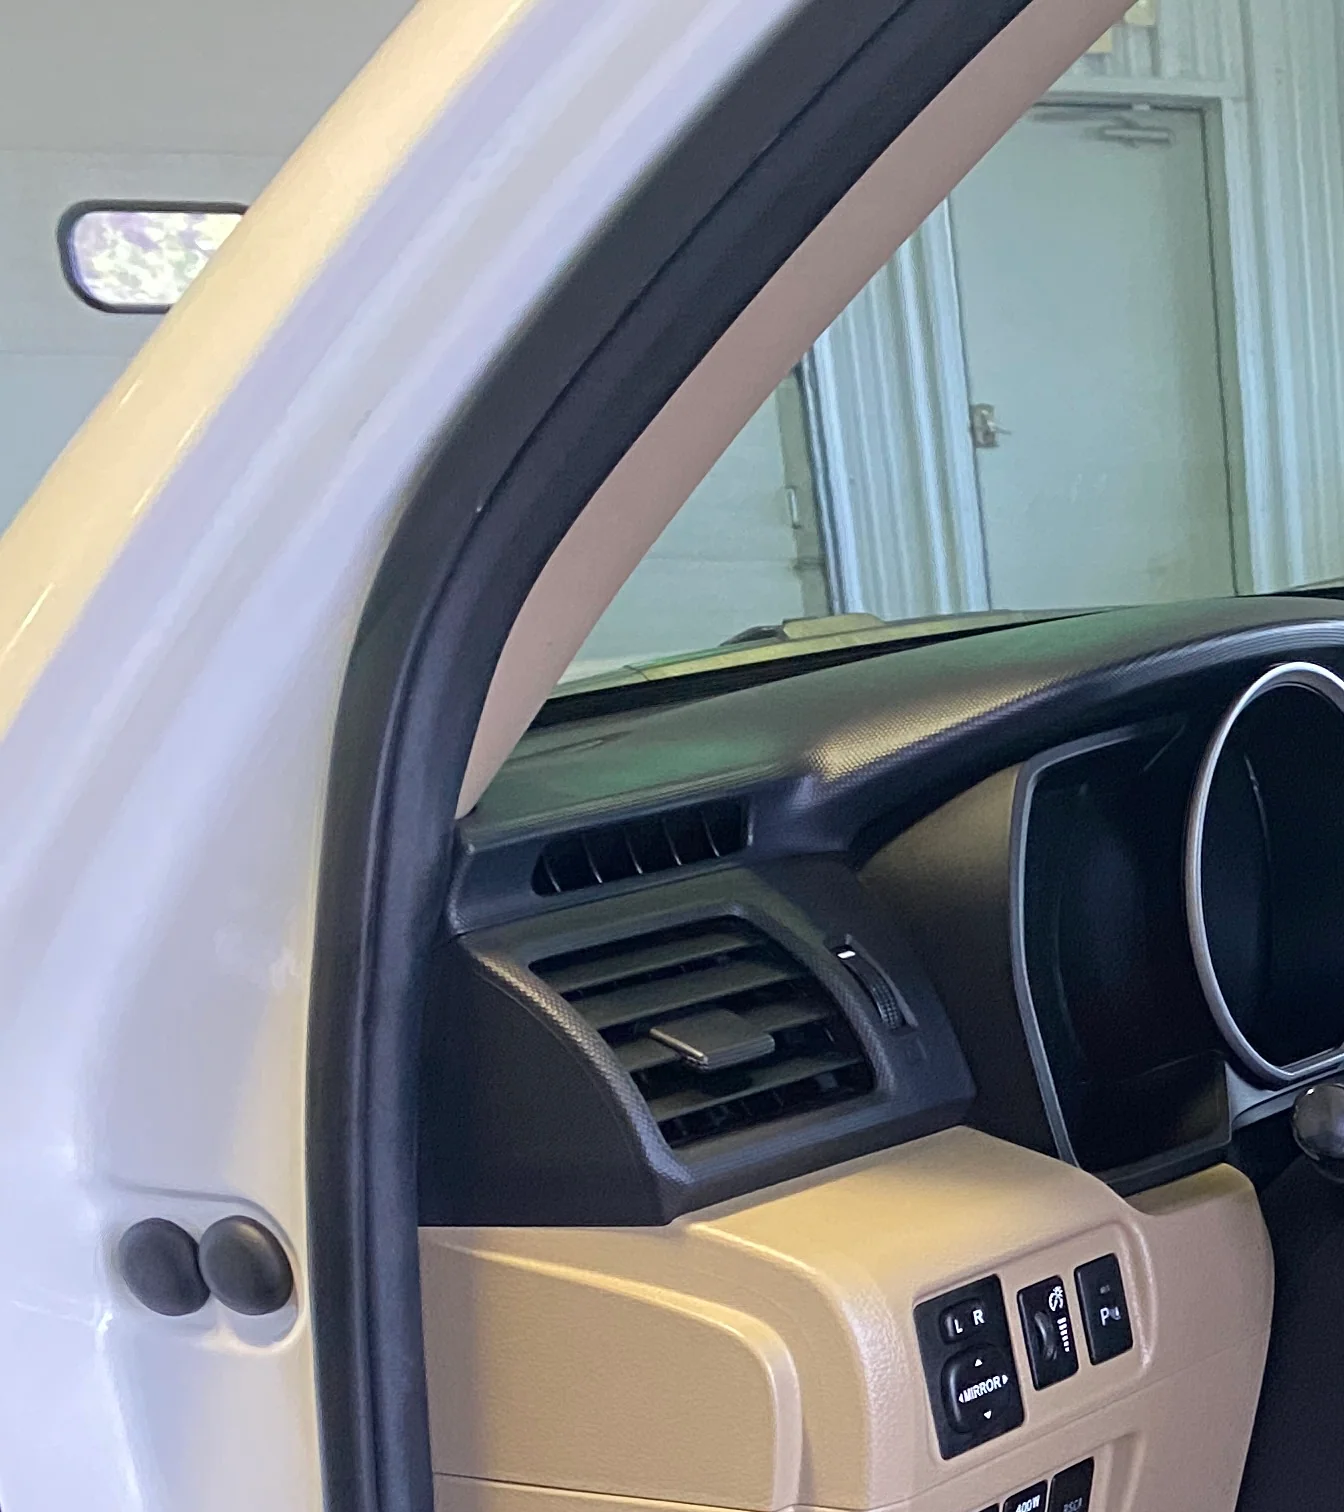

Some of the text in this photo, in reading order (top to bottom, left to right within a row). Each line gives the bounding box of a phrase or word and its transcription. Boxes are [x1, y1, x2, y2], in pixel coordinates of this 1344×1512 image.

[954, 1309, 985, 1334] L R
[964, 1376, 1001, 1403] MIRROR
